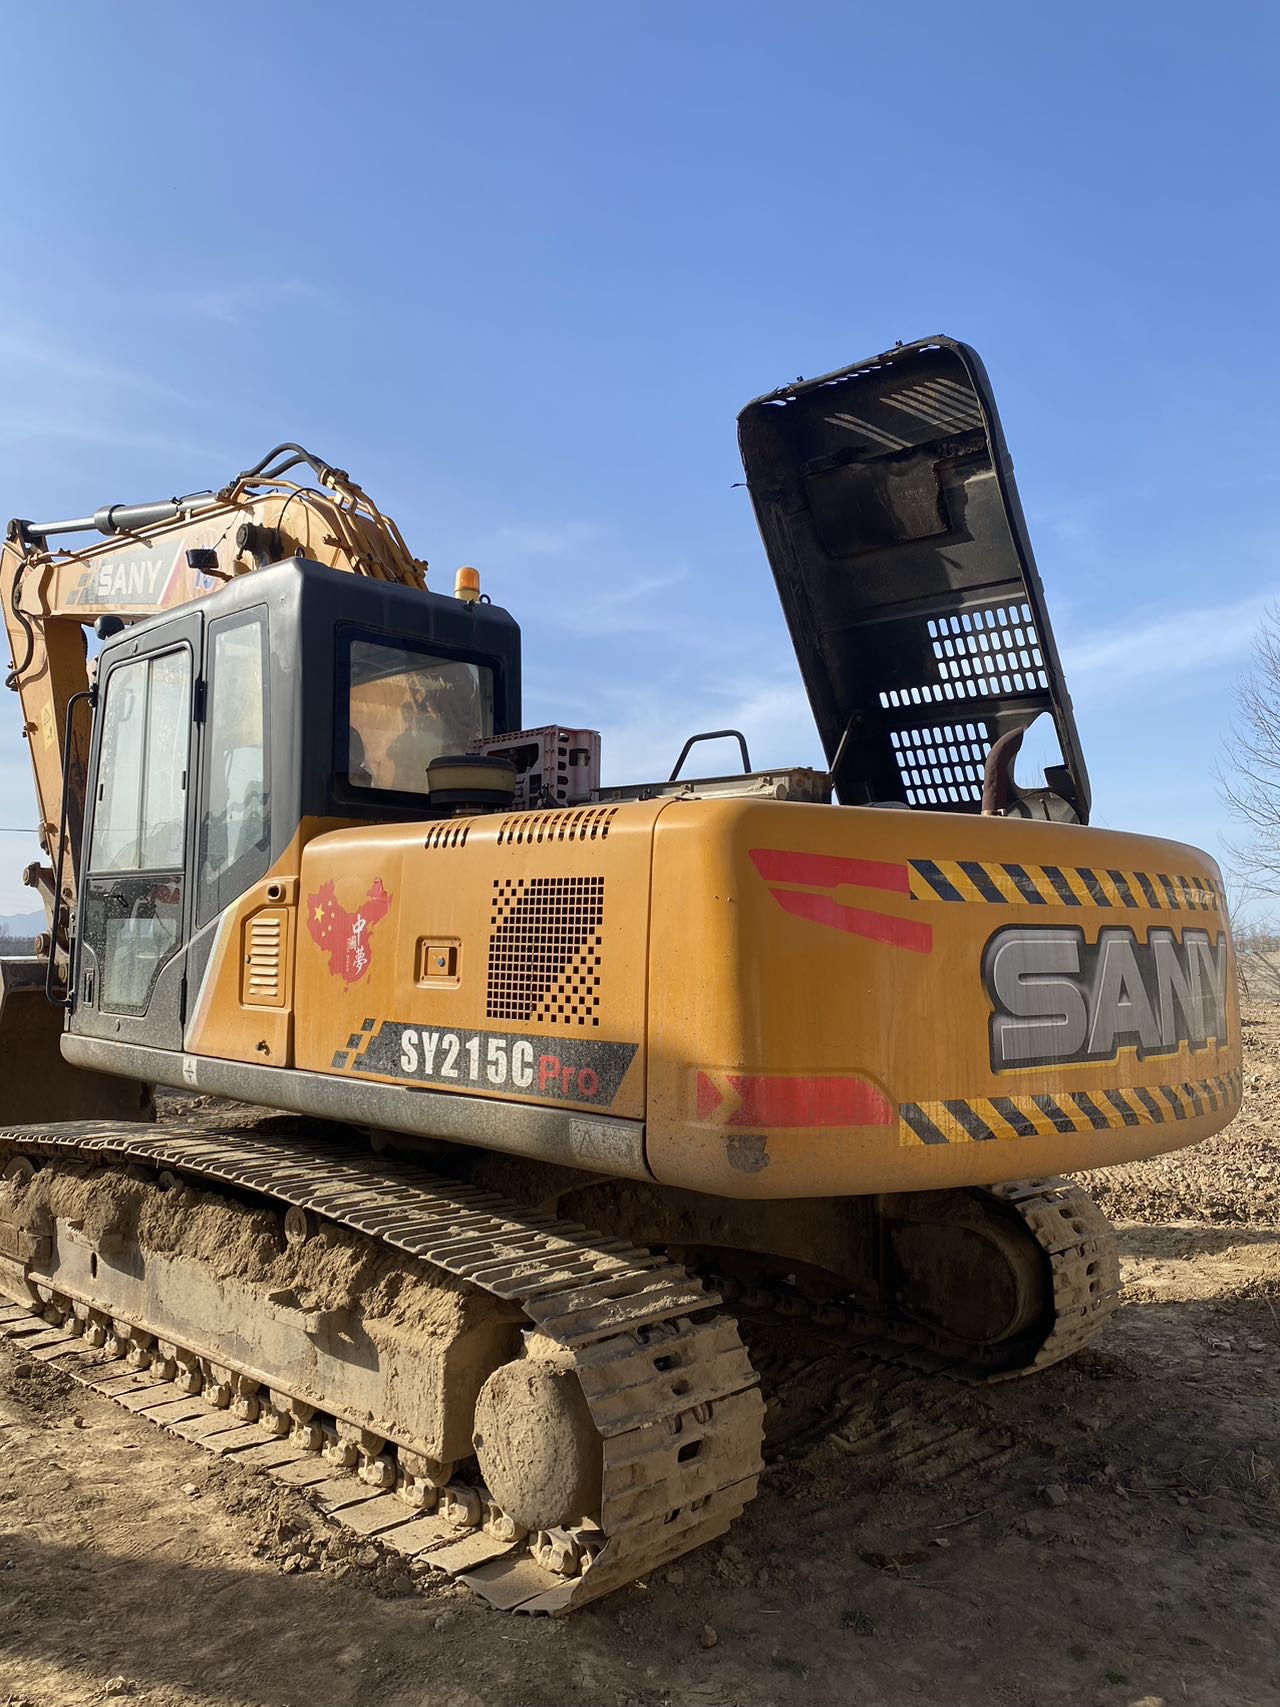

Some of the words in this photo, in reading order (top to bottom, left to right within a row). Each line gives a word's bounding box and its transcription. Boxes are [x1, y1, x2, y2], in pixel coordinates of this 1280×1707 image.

[97, 559, 163, 596] SANY
[988, 930, 1228, 1062] SANY
[400, 1029, 534, 1088] SY215C
[538, 1055, 600, 1098] Pro
